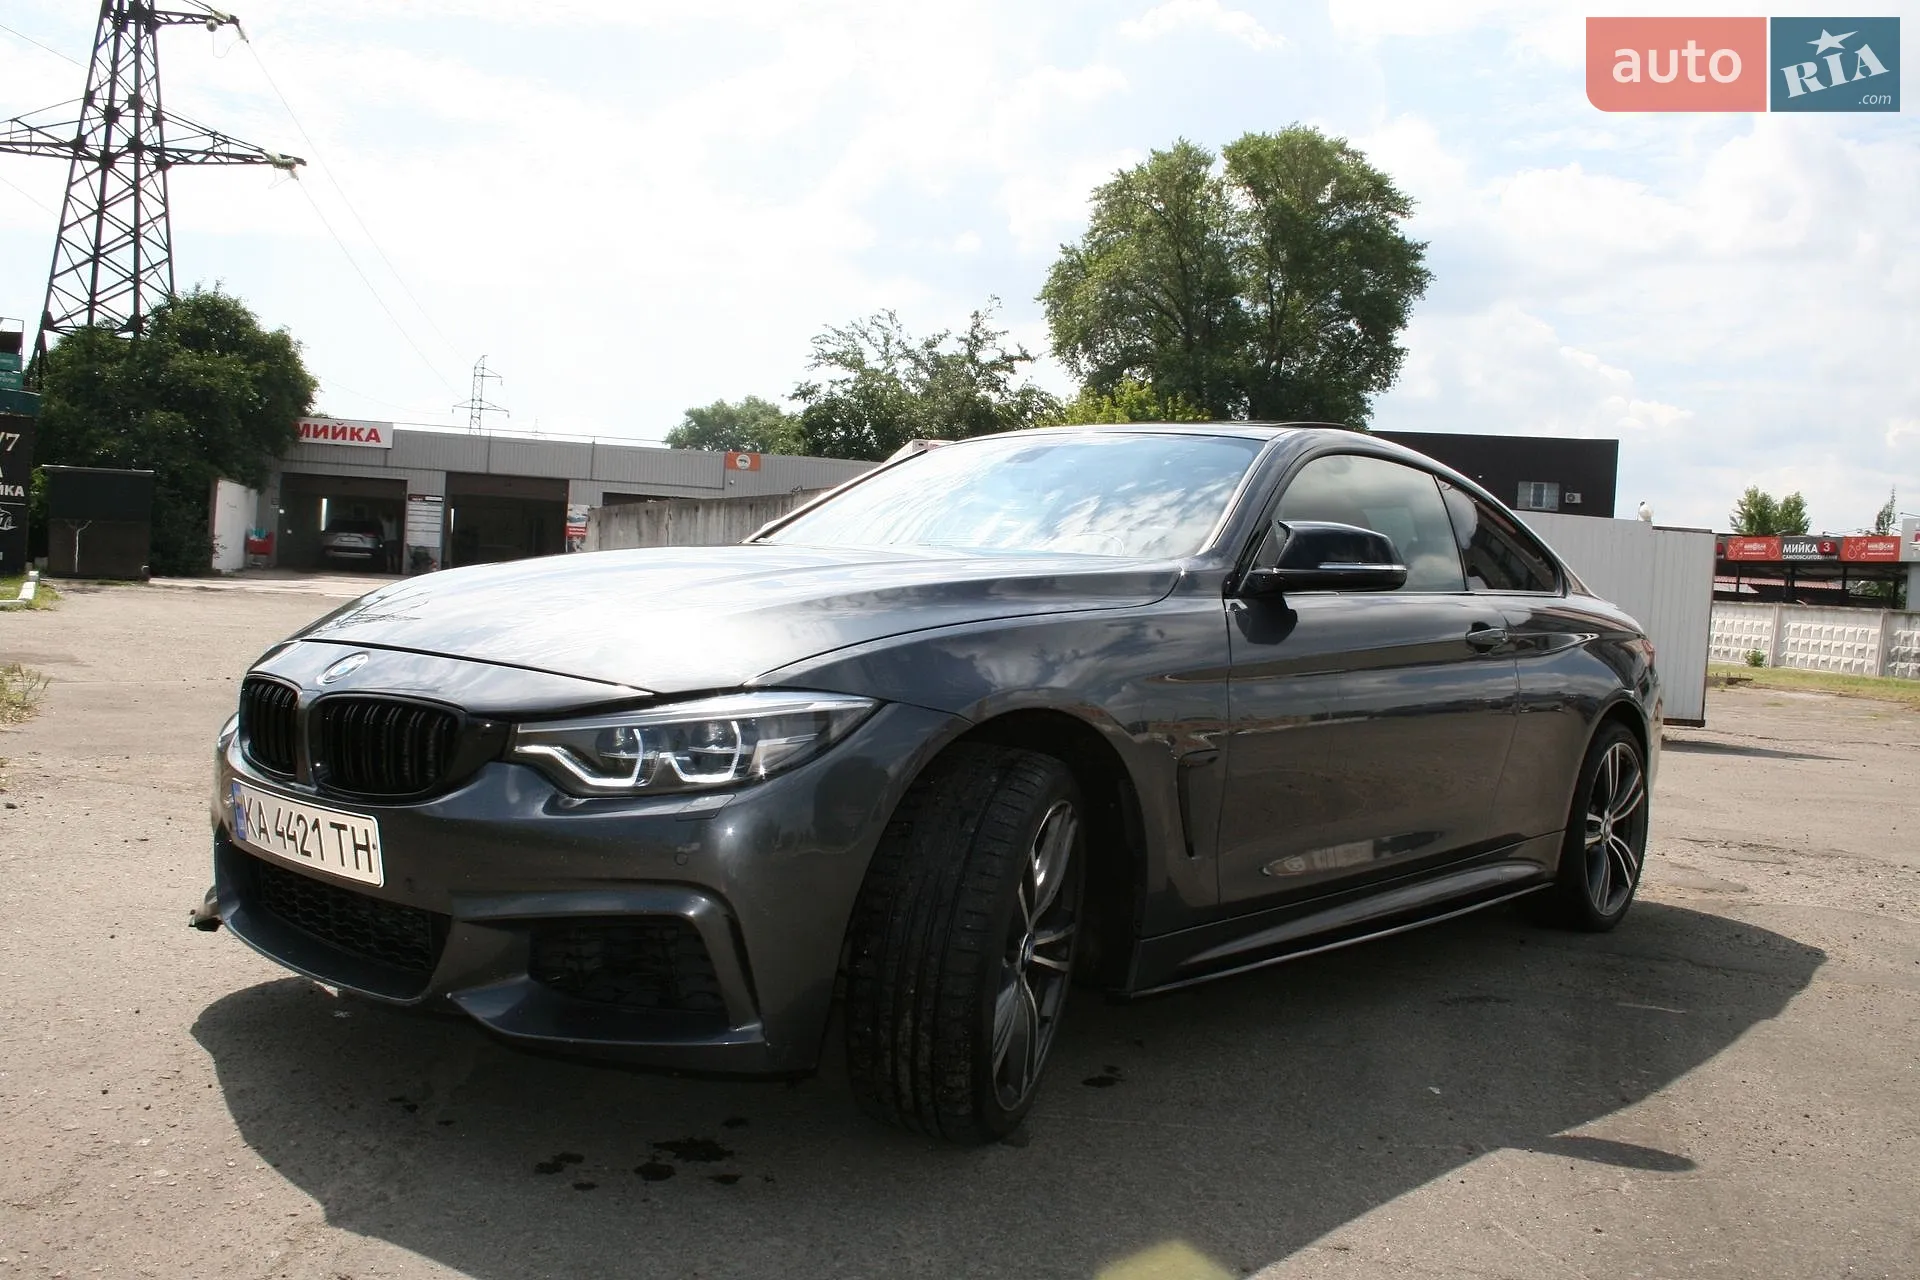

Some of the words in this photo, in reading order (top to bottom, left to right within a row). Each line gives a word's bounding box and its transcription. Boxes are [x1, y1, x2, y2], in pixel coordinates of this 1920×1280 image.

[295, 422, 382, 443] МИЙКА
[1782, 542, 1818, 554] МИЙКА
[1823, 542, 1831, 552] 3
[243, 794, 272, 844] KA
[274, 807, 326, 861] 4421
[329, 821, 373, 873] TH
